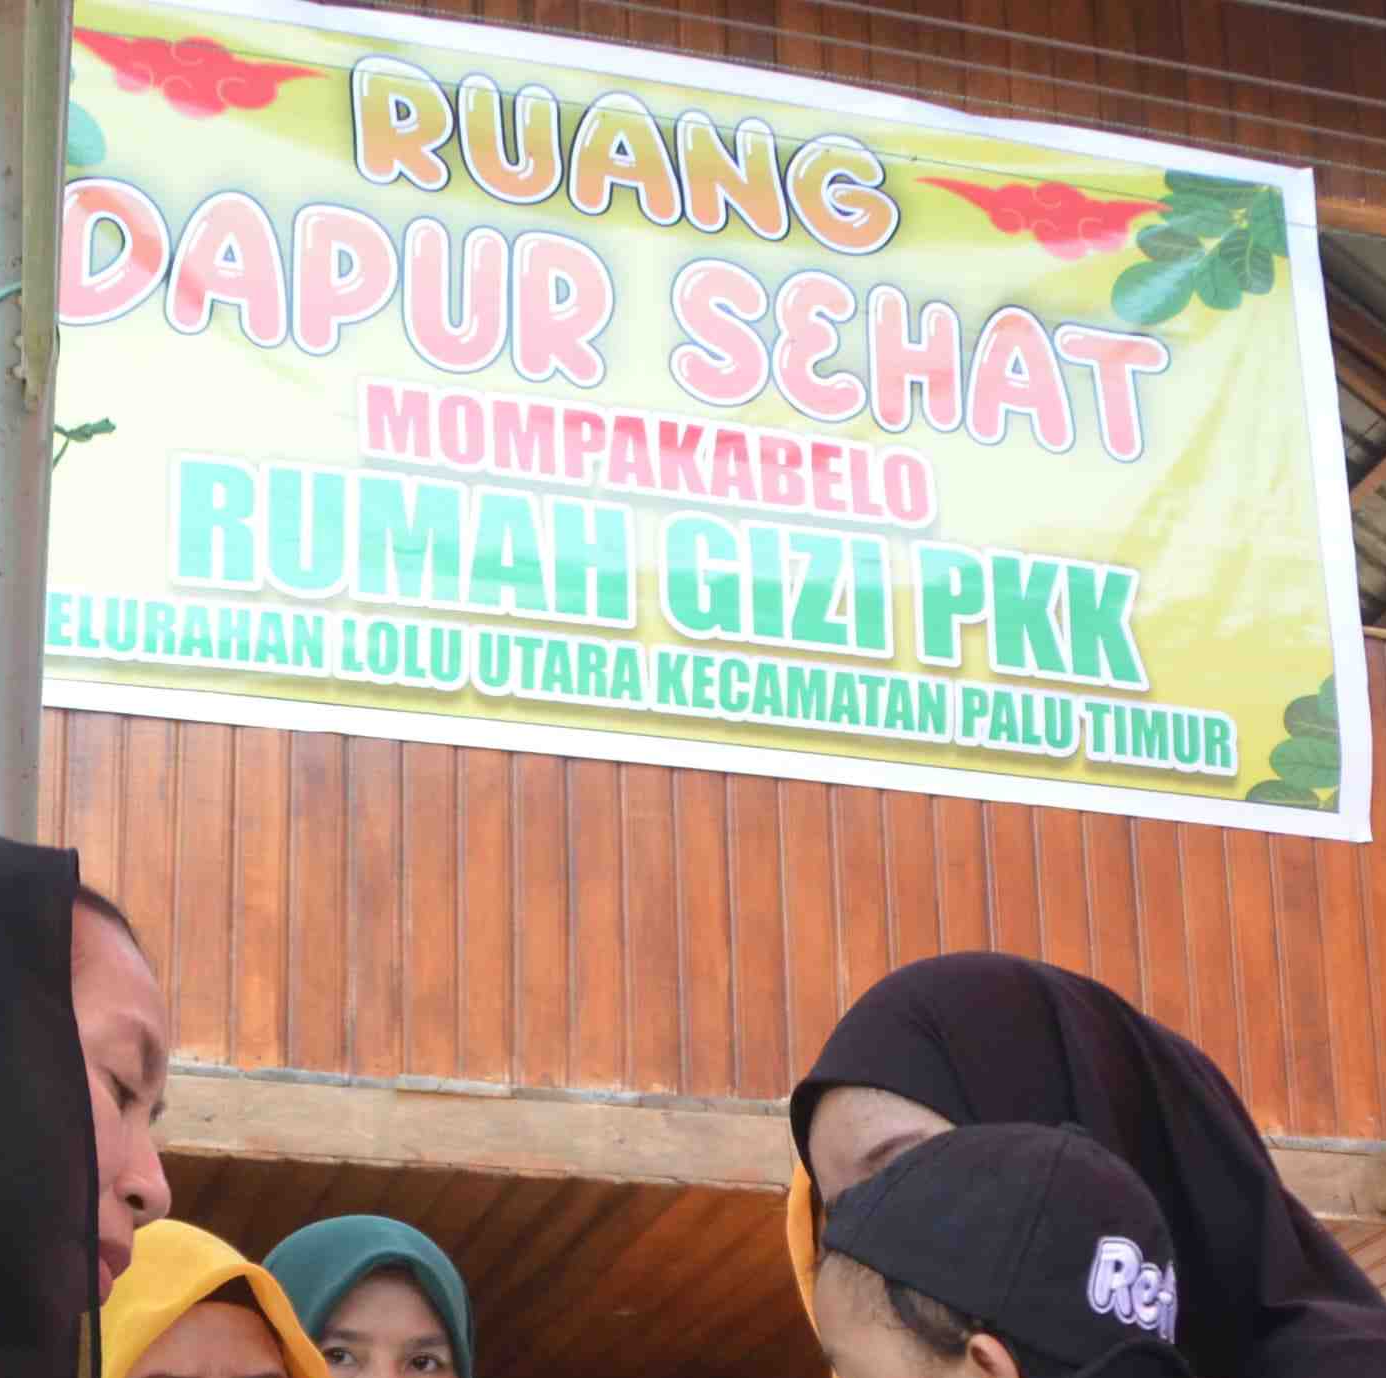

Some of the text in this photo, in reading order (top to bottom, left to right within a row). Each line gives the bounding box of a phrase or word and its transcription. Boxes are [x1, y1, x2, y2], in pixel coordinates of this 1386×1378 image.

[351, 56, 901, 255] RUANG
[56, 178, 1172, 463] DAPUR SEHAT
[367, 385, 930, 523] MOMPAKABELO
[178, 461, 1144, 685] RUMAH GIZI PKK
[48, 593, 1234, 769] ELURAHAN LOLU UTARA KECAMATAN PALU TIMUR
